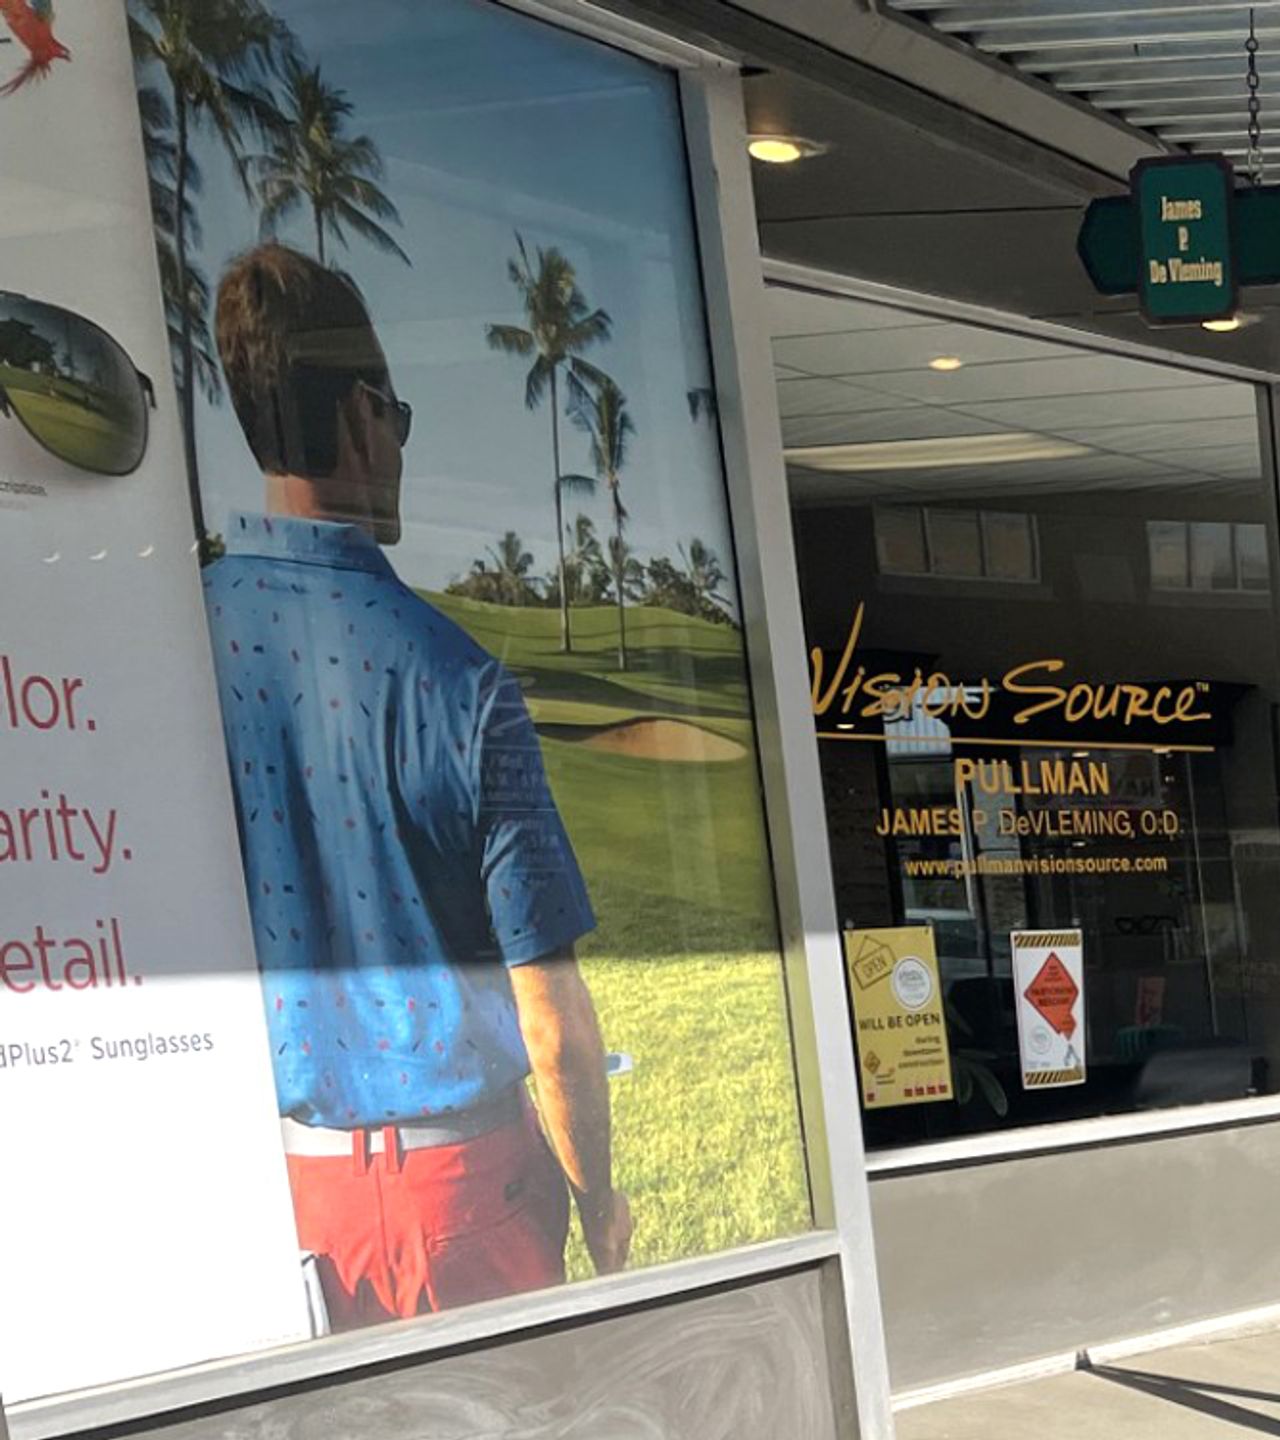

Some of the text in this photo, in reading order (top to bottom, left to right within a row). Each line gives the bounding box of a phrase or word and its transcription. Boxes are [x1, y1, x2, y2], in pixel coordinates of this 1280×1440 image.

[1161, 196, 1202, 222] James
[955, 758, 1110, 796] PULLMAN
[876, 807, 964, 837] JAMES
[904, 856, 1167, 879] www.pullmanvisionsource.com
[859, 1012, 940, 1031] WILL BE OPEN
[90, 1031, 215, 1061] Sunglasses
